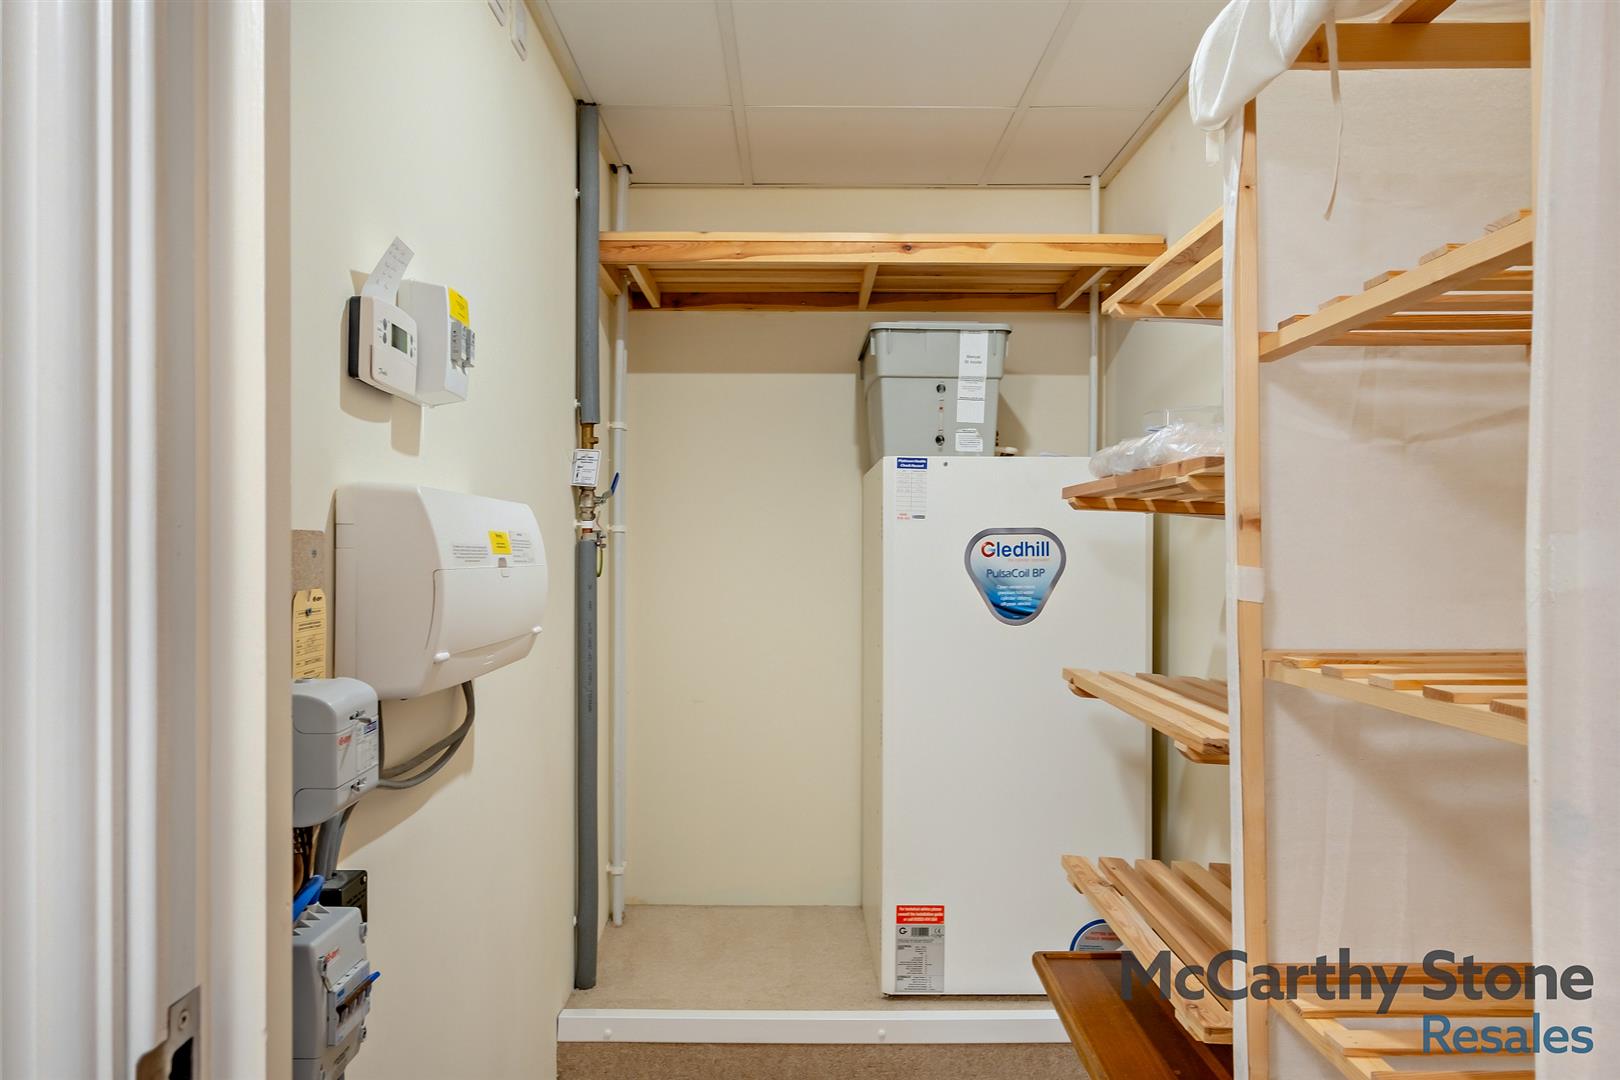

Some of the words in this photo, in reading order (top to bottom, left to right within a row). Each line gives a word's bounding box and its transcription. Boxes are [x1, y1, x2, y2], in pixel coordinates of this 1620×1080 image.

[981, 541, 1050, 558] Gledhill
[986, 568, 1030, 578] PulsaCoil
[1032, 568, 1046, 578] BP
